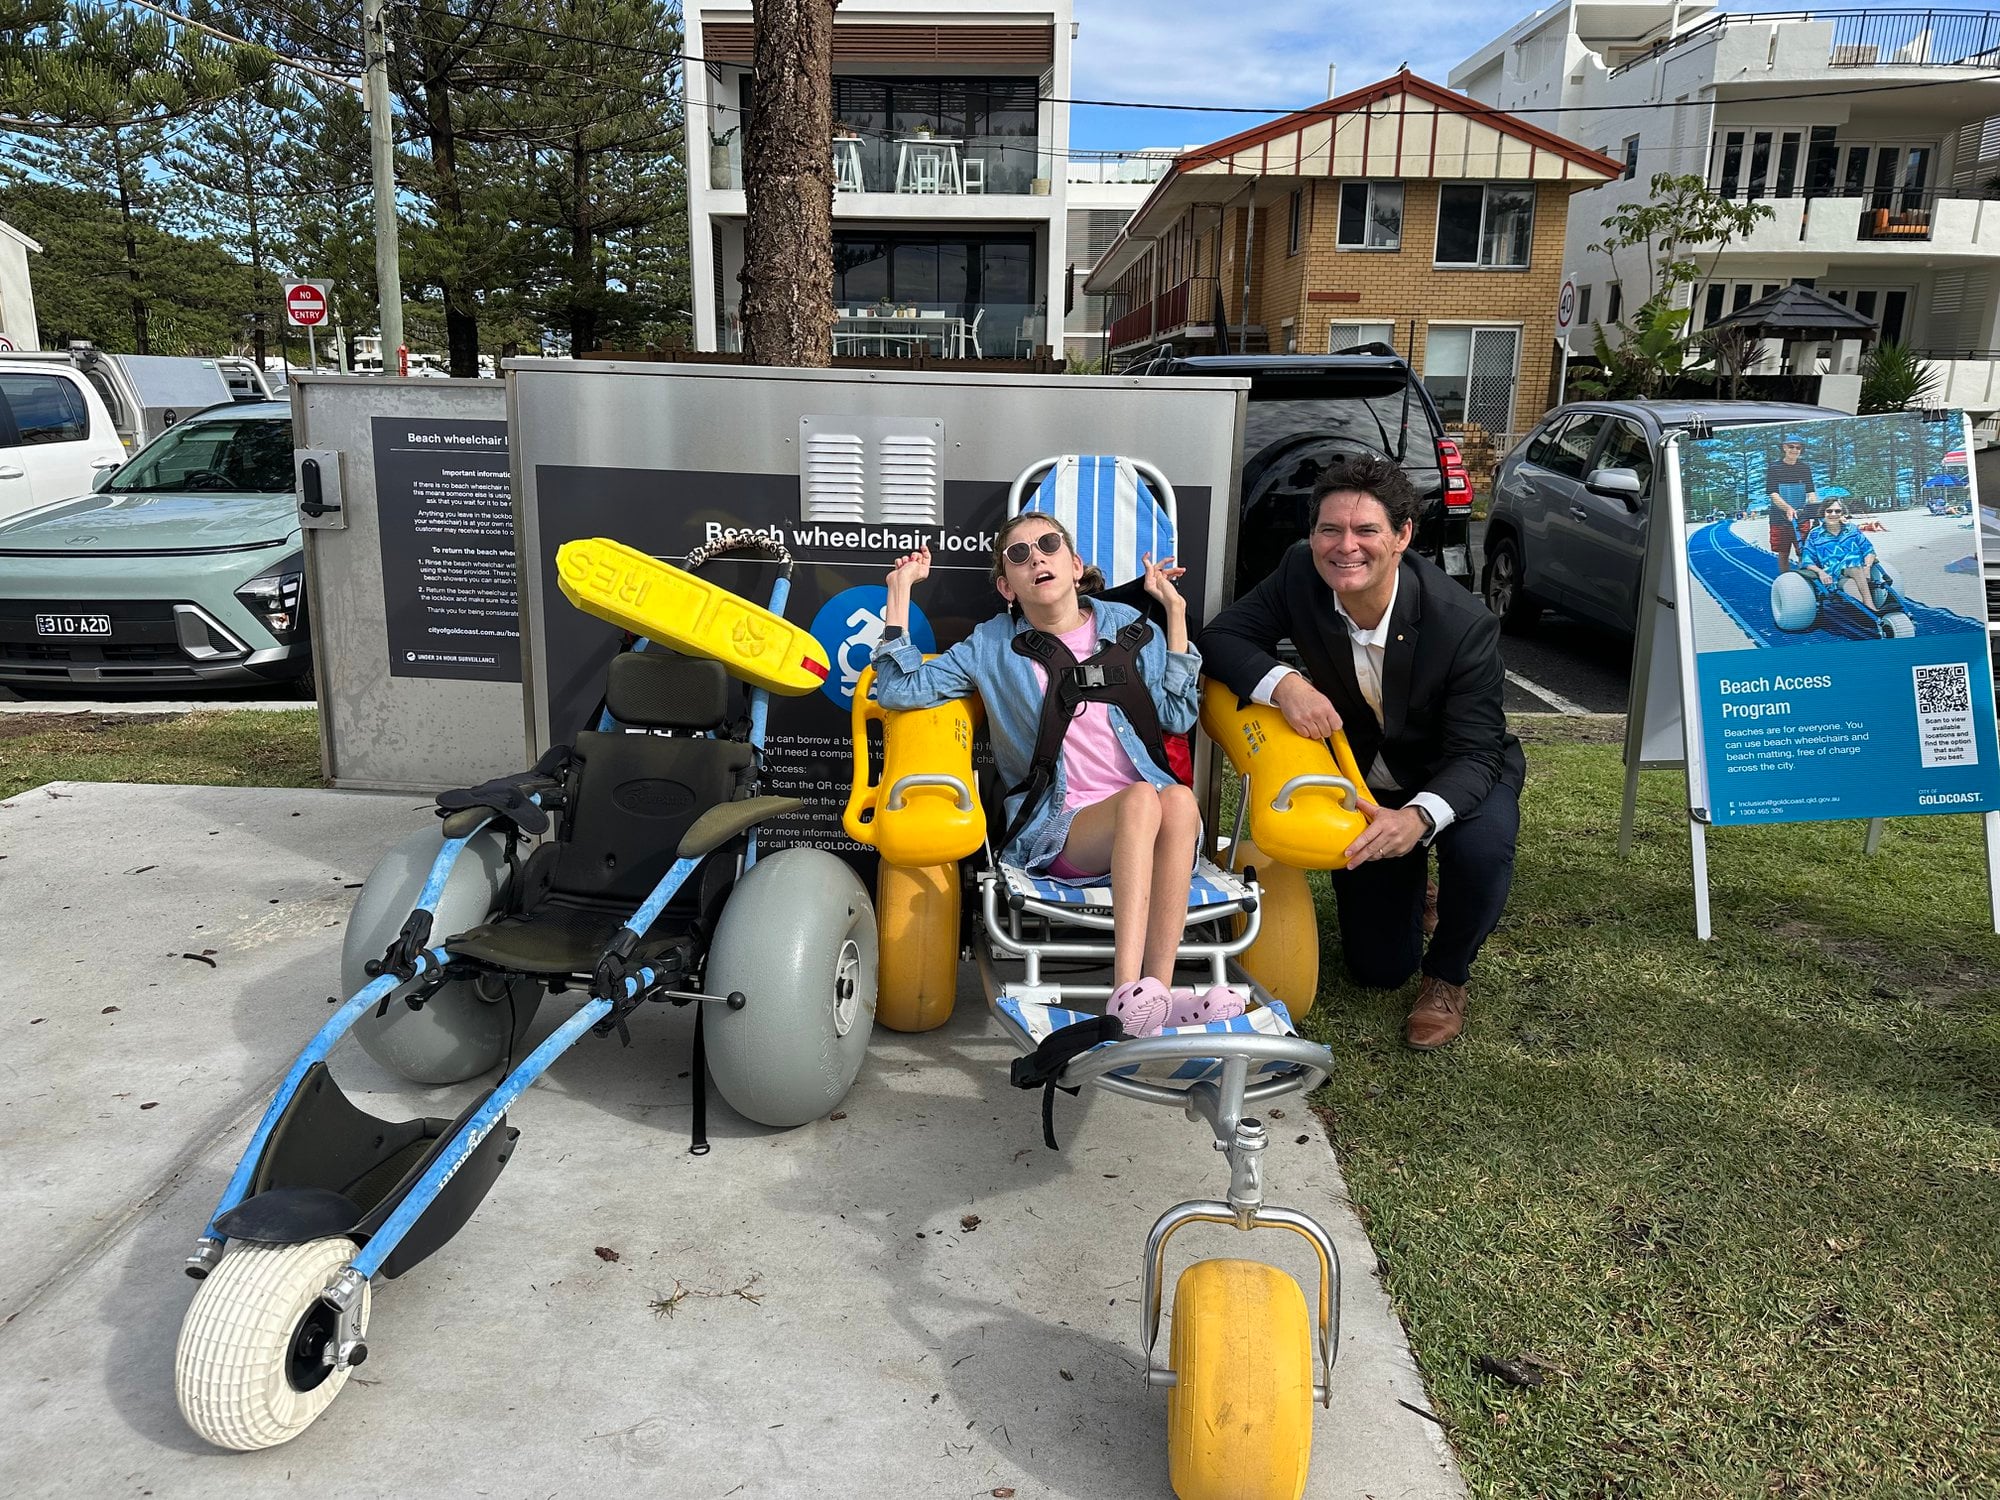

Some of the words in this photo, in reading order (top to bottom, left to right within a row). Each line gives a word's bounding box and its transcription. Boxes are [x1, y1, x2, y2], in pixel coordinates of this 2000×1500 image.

[1561, 294, 1571, 313] 40
[408, 432, 440, 443] Beach
[444, 434, 502, 445] wheelchair
[442, 469, 475, 477] Important
[705, 522, 784, 546] Beach
[793, 525, 931, 550] wheelchair
[940, 530, 999, 552] lock
[1720, 677, 1769, 695] Beach
[1774, 674, 1832, 691] Access
[1722, 702, 1790, 719] Program
[1724, 728, 1764, 737] Beaches
[1783, 726, 1796, 734] for
[1798, 723, 1843, 733] everyone.
[1845, 720, 1863, 729] You
[797, 735, 830, 745] borrow
[1764, 737, 1792, 747] beach
[1794, 734, 1849, 745] wheelchairs
[1851, 732, 1869, 741] and
[785, 748, 808, 756] need
[1726, 751, 1754, 760] beach
[1758, 749, 1795, 760] matting,
[1797, 747, 1814, 756] free
[1817, 747, 1826, 755] of
[1829, 745, 1860, 755] charge
[1728, 764, 1758, 773] across
[1760, 763, 1775, 771] the
[1778, 762, 1796, 771] city.
[772, 780, 796, 789] Scan
[799, 780, 814, 789] the
[817, 781, 831, 791] QR
[821, 797, 836, 805] the
[1919, 793, 1983, 805] GOLDCOAST.
[758, 827, 773, 835] For
[815, 842, 876, 851] GOLDCOAS
